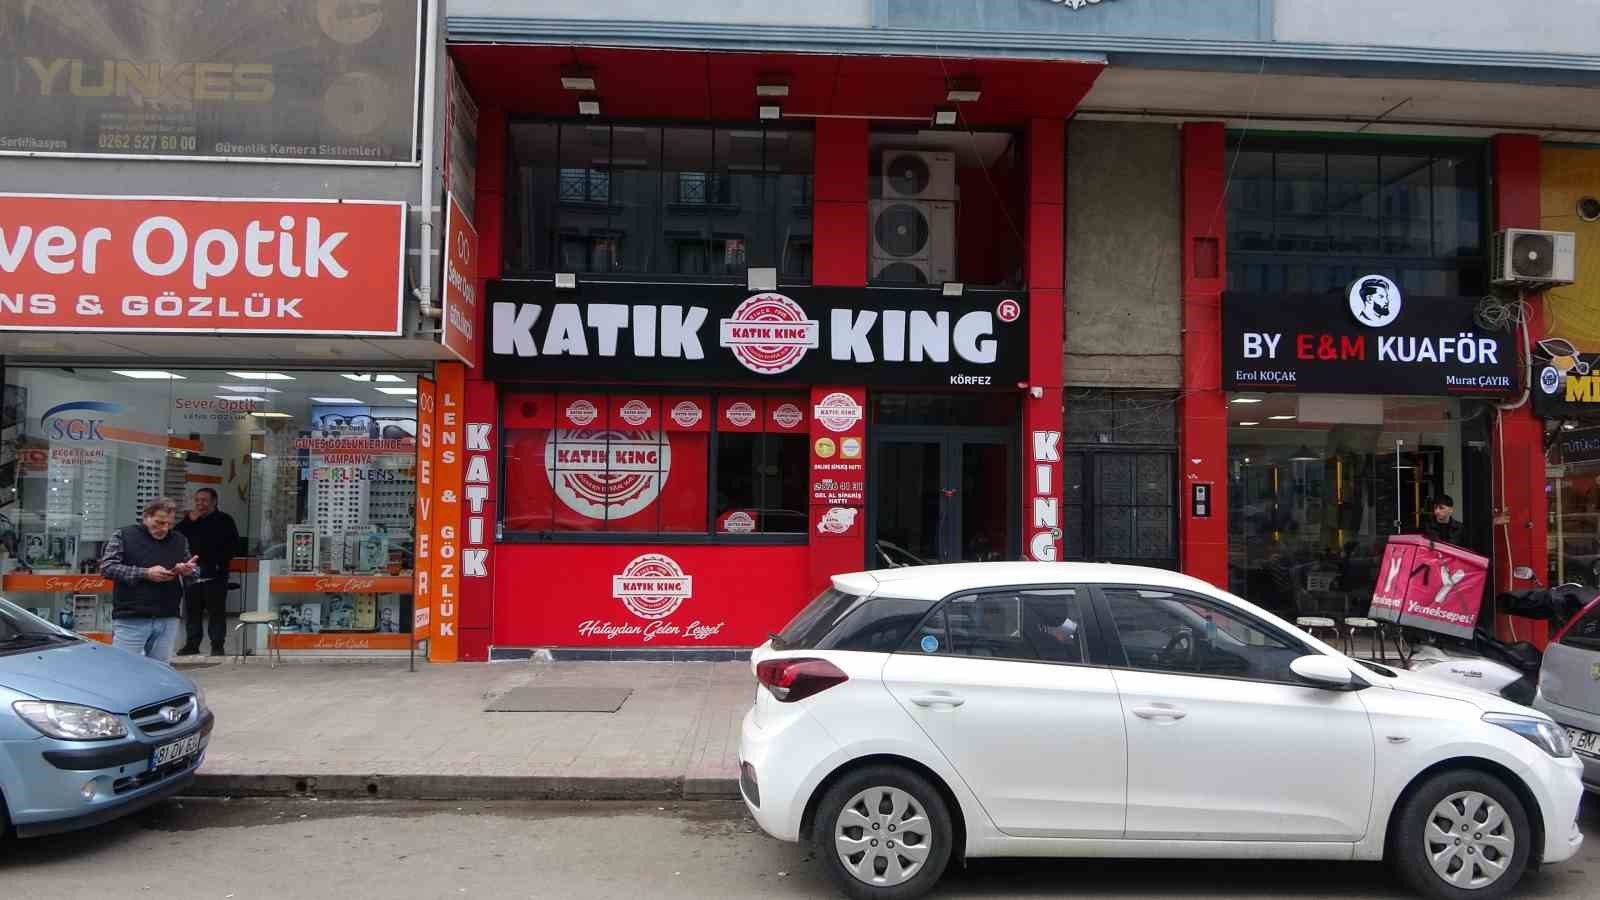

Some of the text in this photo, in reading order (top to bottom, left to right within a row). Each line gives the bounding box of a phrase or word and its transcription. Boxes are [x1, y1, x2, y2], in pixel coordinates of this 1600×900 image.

[98, 134, 196, 150] 0262 527 60 00
[270, 143, 317, 155] Kamera
[132, 214, 349, 289] Optik
[75, 294, 104, 315] &
[121, 291, 304, 319] GÖZLÜK
[492, 301, 709, 360] KATIK
[830, 308, 998, 363] KING
[732, 327, 806, 339] KATIK KING
[1243, 332, 1499, 365] BY E&M KUAFÖR
[950, 374, 991, 385] KÖRFEZ
[1236, 370, 1297, 384] Erol KOÇAK
[1446, 375, 1510, 388] Murat ÇAYIR
[175, 399, 257, 412] Sever Optik
[51, 418, 104, 441] SGK
[323, 454, 372, 465] KAMPANYA
[558, 449, 658, 465] KATIK KING
[359, 468, 395, 480] LENS
[463, 422, 491, 577] KATIK
[1030, 431, 1061, 561] KING
[440, 393, 456, 637] LENS & GÖZLÜK
[623, 582, 682, 591] KATIK KING
